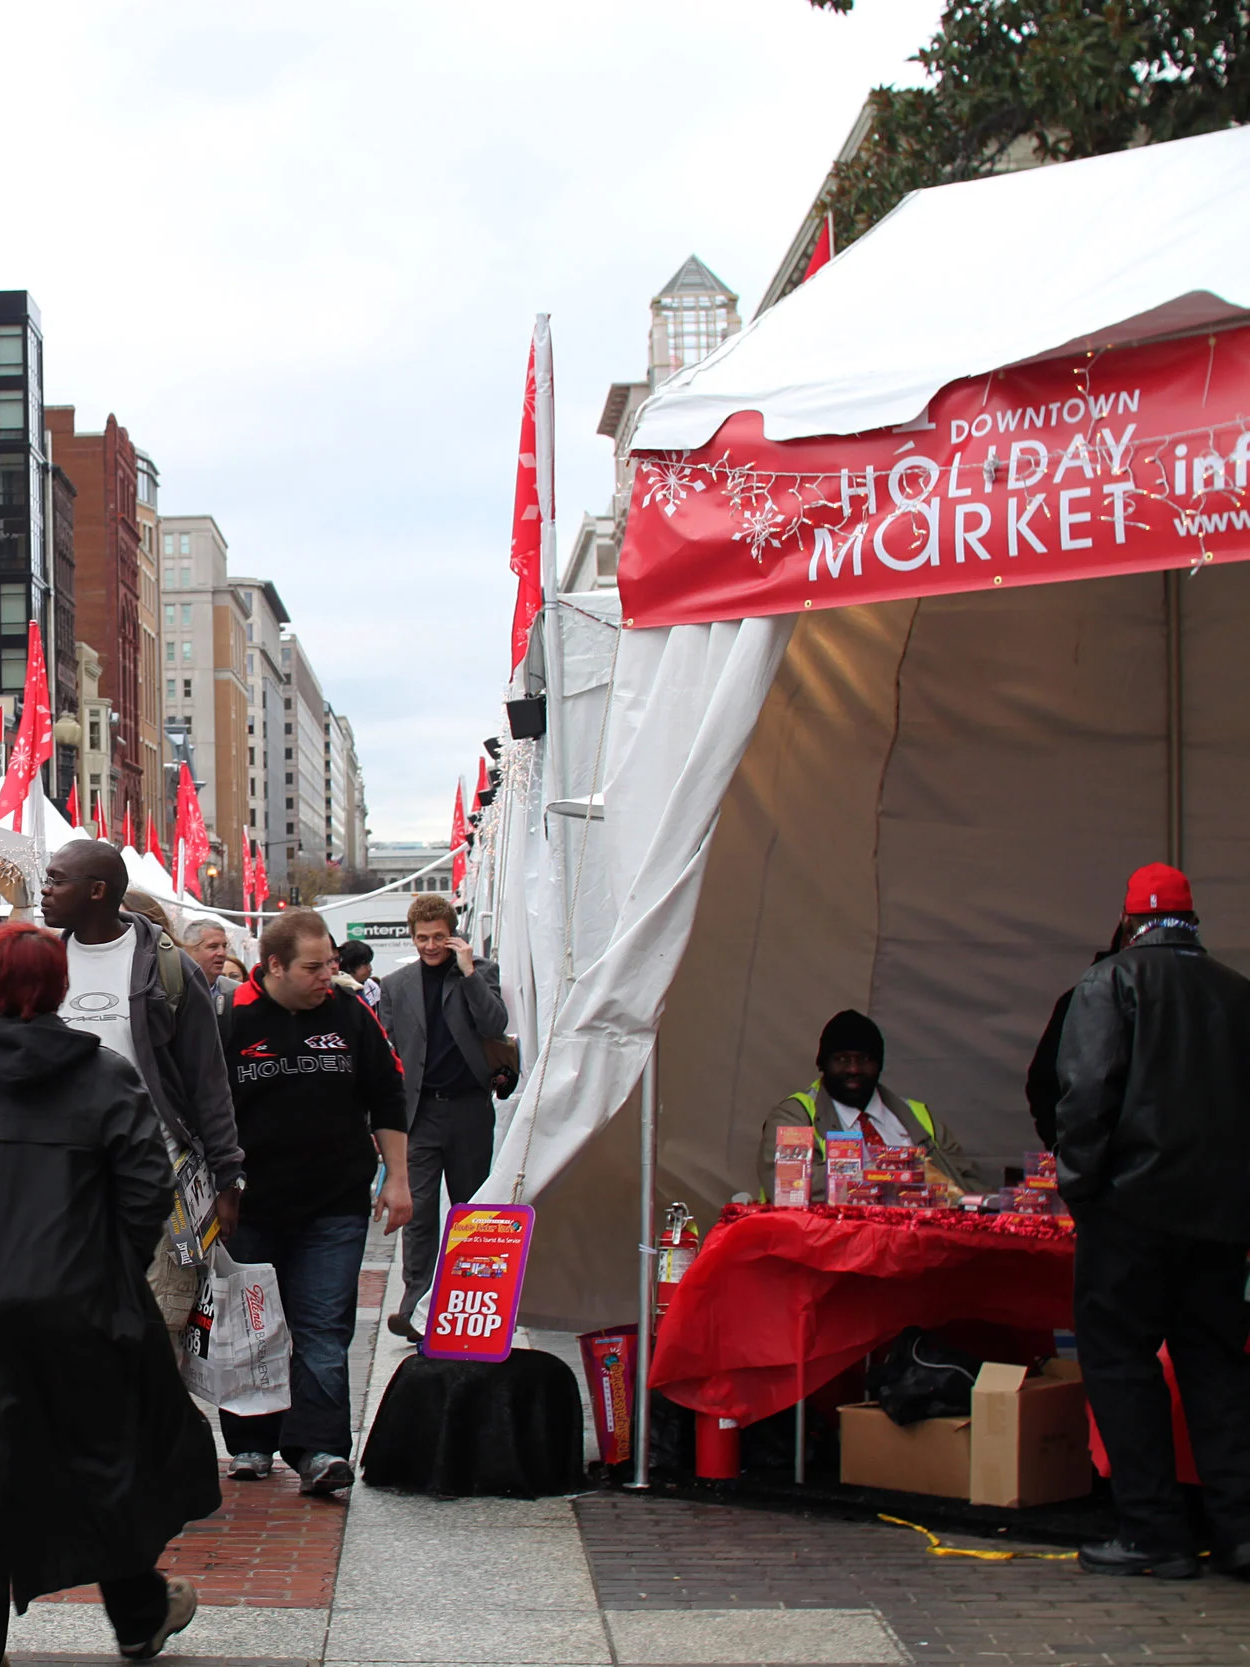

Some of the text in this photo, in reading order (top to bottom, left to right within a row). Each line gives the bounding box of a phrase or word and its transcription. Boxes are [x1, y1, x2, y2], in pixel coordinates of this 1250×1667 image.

[951, 390, 1140, 444] DOWNTOWN
[840, 423, 1138, 517] HOLIDAY
[237, 1055, 352, 1083] HOLDEN
[448, 1290, 499, 1315] BUS
[246, 1284, 270, 1386] Filene's BASEMENT
[436, 1312, 502, 1338] STOP
